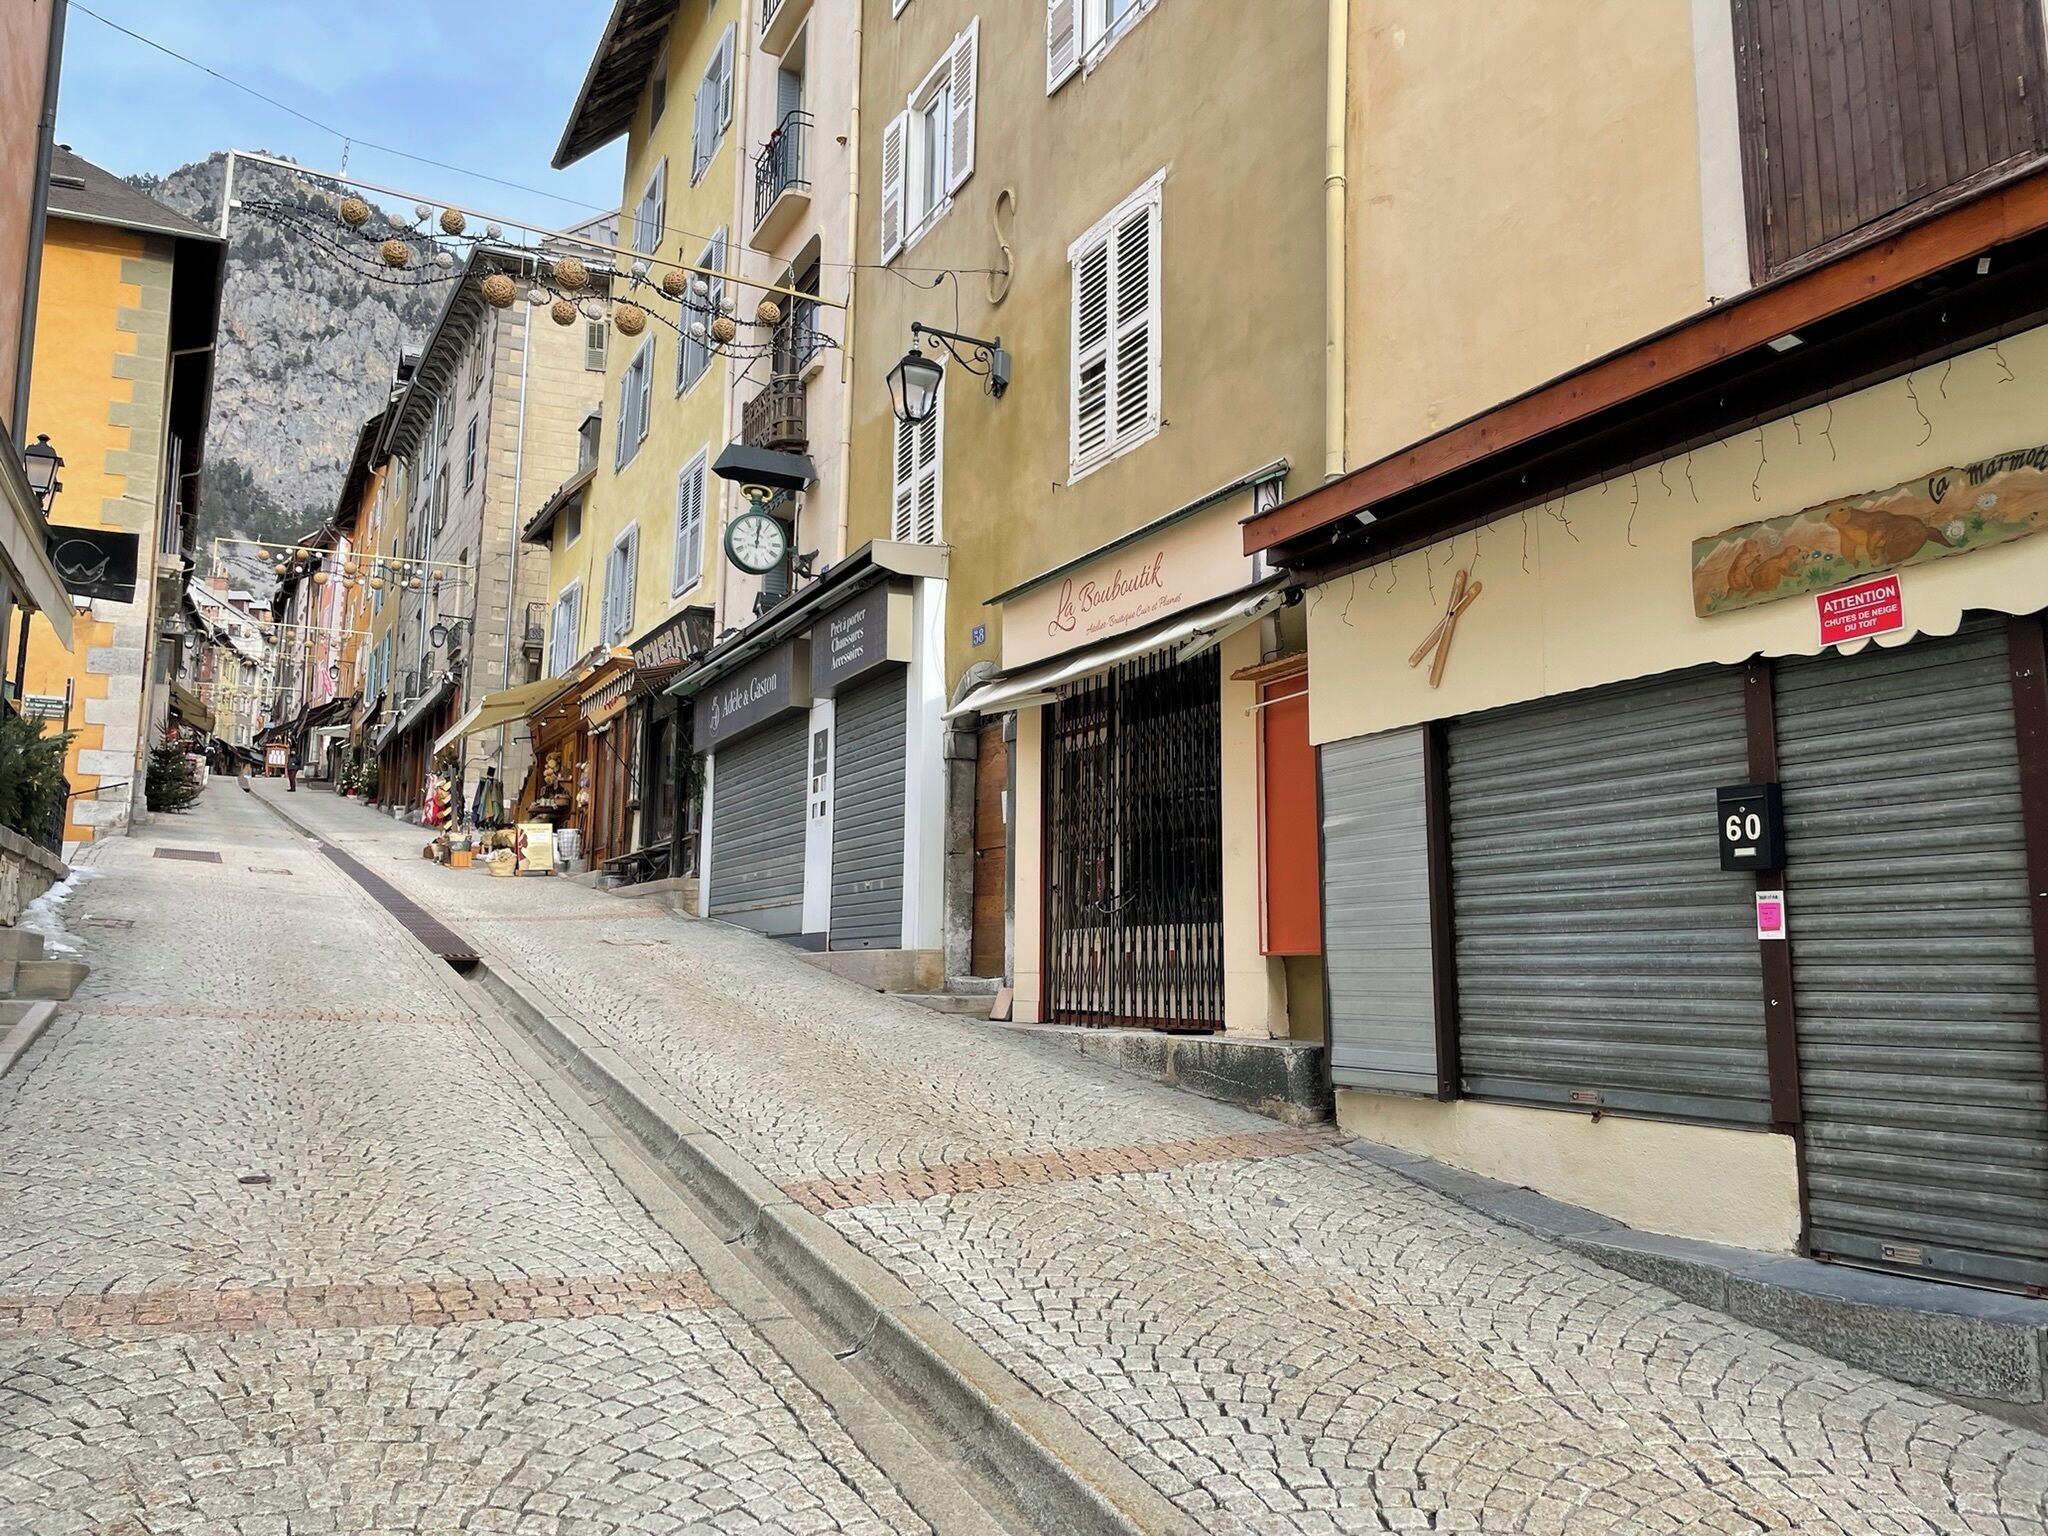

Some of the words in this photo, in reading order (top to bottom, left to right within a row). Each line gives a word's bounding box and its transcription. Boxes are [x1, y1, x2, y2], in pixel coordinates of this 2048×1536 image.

[1048, 578, 1077, 637] La
[1079, 552, 1164, 612] Bouboutik
[1823, 585, 1896, 614] ATTENTION
[846, 608, 866, 633] porter
[1824, 613, 1857, 628] CHUTES
[1858, 610, 1871, 620] DE
[1871, 603, 1898, 617] NEIGE
[1844, 623, 1857, 633] DU
[1858, 617, 1878, 629] TOIT
[831, 628, 864, 653] Chaussures
[973, 627, 984, 645] 58
[831, 646, 864, 671] Accessoires
[743, 689, 750, 706] &
[750, 673, 777, 702] Gaston
[1725, 813, 1761, 842] 60
